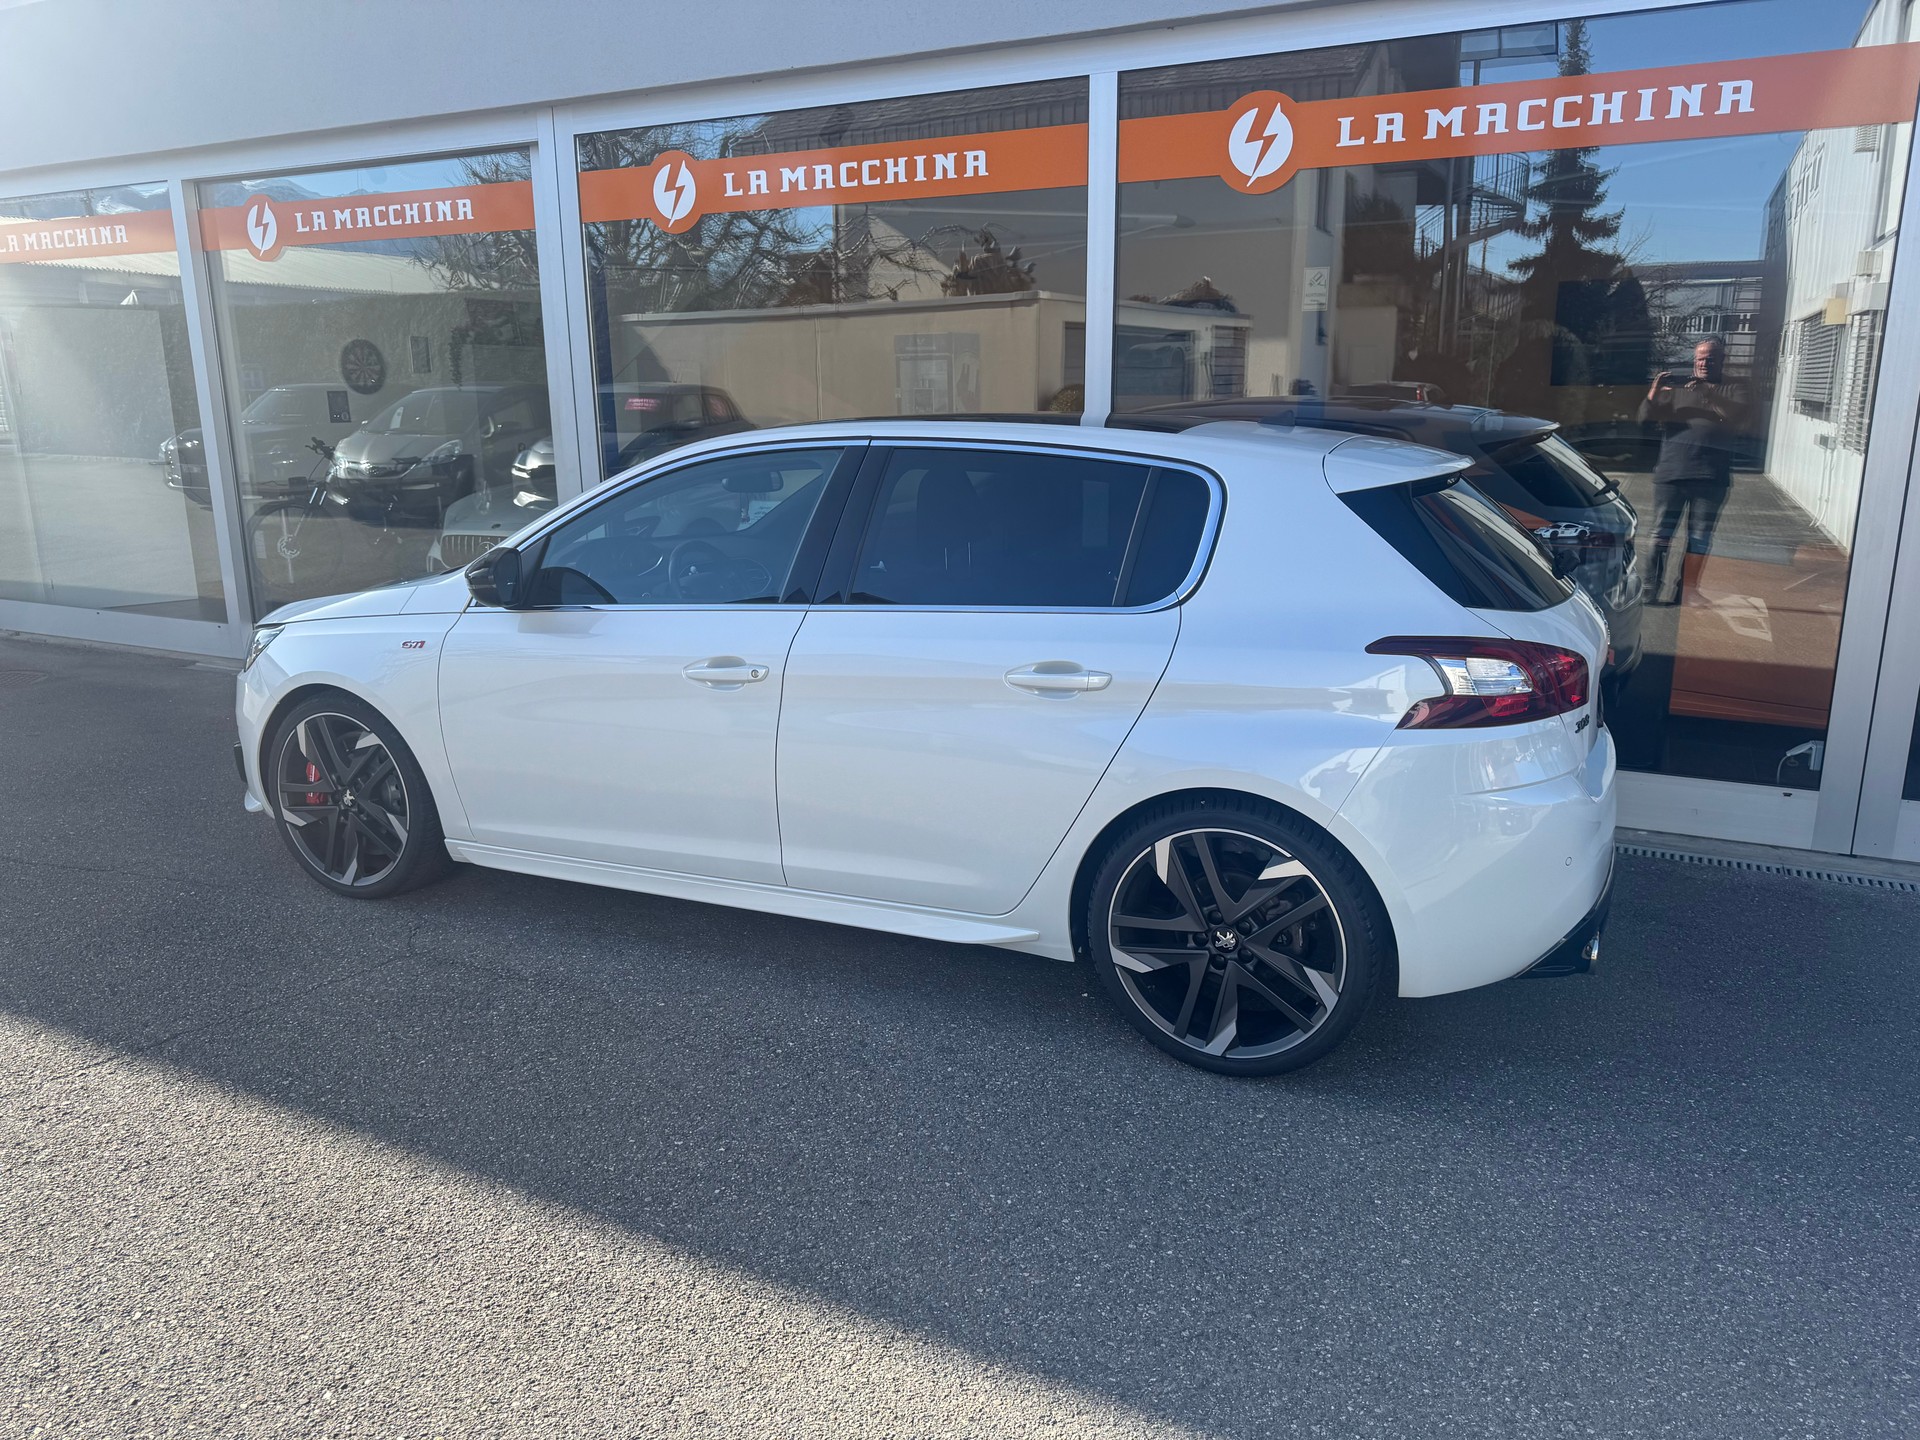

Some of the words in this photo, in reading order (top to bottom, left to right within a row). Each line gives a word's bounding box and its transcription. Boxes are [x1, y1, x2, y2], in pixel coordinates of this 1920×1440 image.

[1336, 112, 1406, 147] LA
[1422, 79, 1755, 140] MACCHINA
[723, 169, 770, 197] LA
[779, 150, 989, 192] MACCHINA
[294, 211, 328, 233] LA
[332, 198, 475, 230] MACCHINA
[24, 224, 129, 251] MACCHINA
